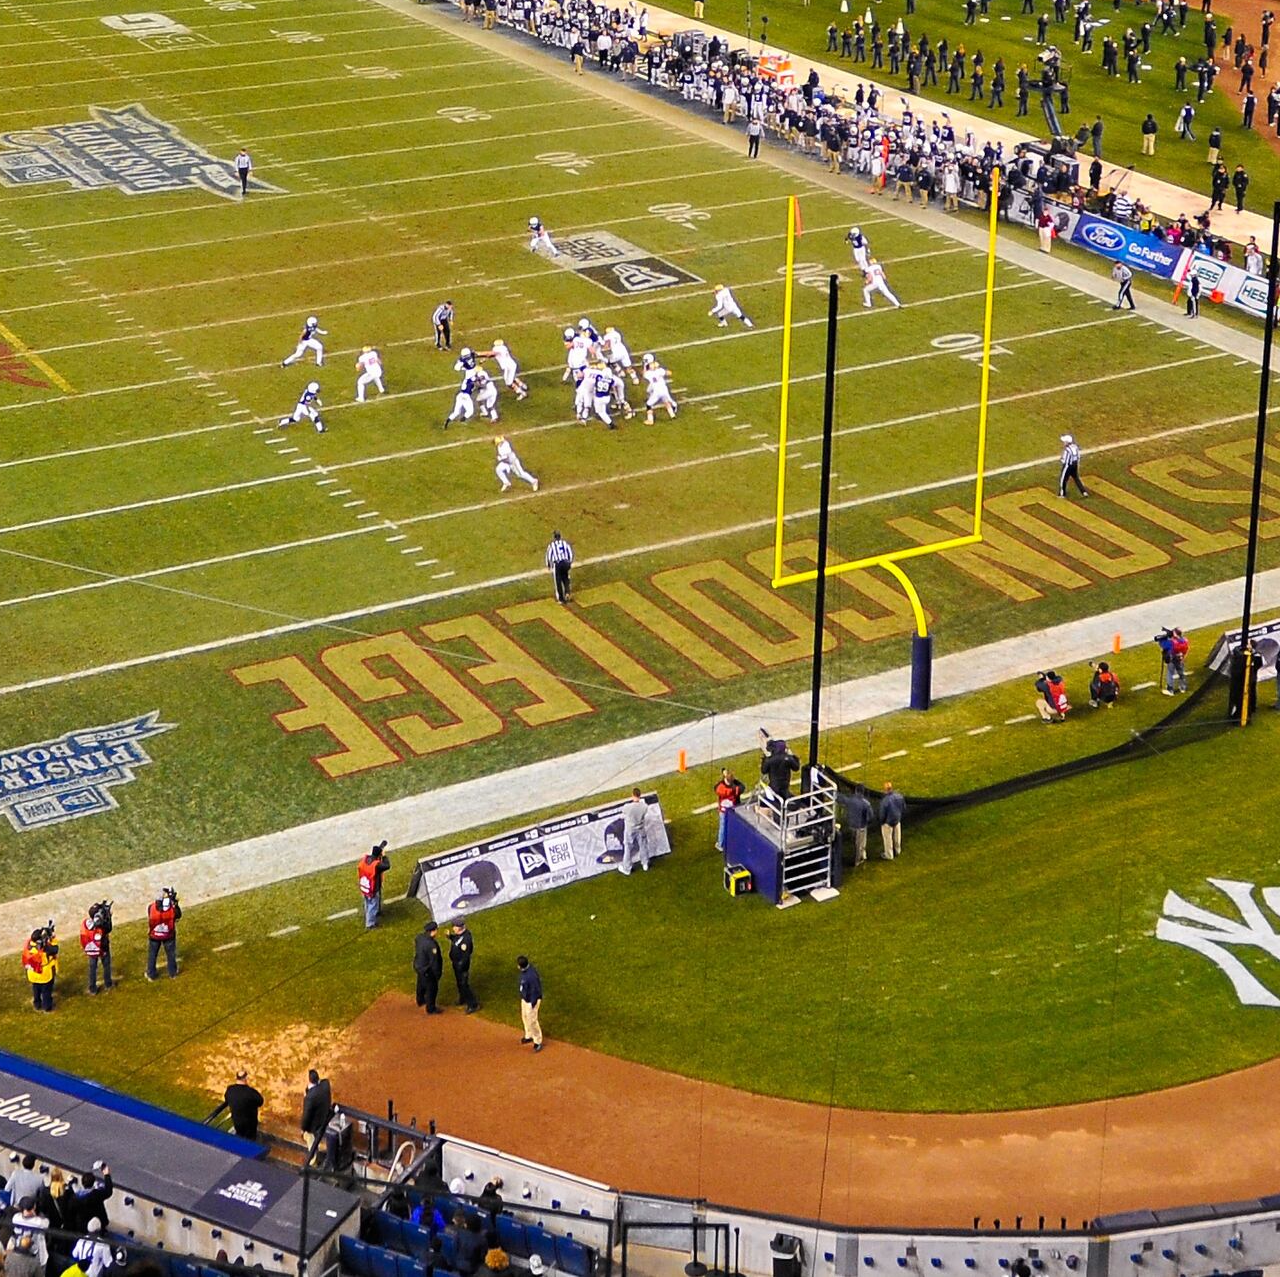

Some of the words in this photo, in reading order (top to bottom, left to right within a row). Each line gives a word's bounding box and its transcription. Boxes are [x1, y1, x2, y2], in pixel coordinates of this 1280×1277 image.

[1088, 226, 1118, 248] Ford
[1128, 242, 1143, 256] Go
[1142, 247, 1174, 266] Further
[229, 534, 936, 779] COLLEGE
[549, 842, 569, 855] NEW
[551, 852, 571, 865] ERA
